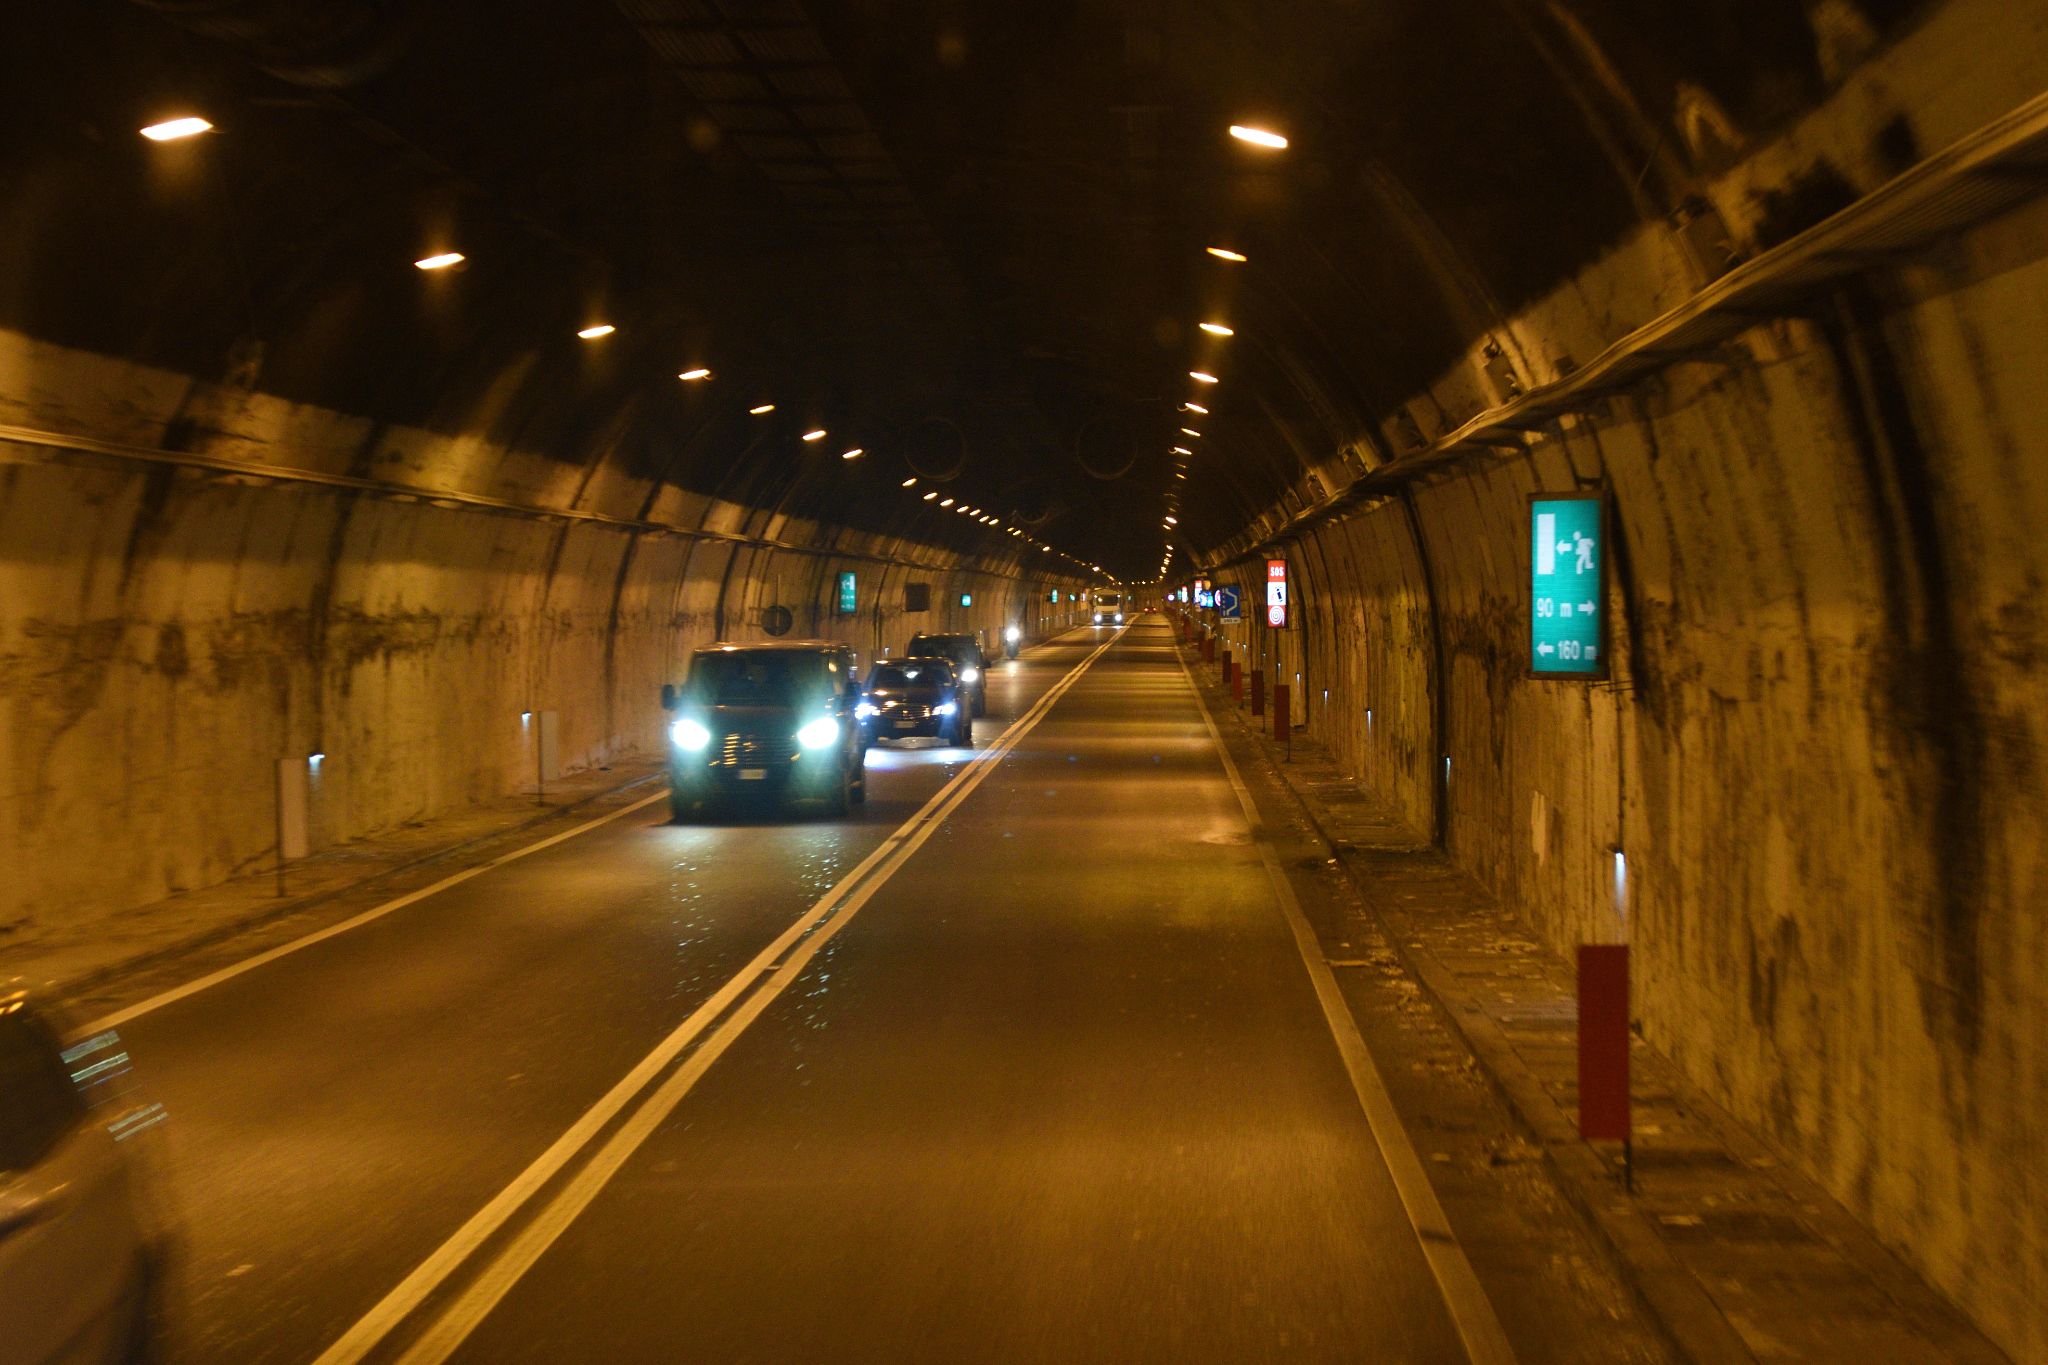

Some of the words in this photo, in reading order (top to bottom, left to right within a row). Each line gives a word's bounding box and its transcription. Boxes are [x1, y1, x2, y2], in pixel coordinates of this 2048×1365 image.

[1270, 566, 1284, 577] SOS
[1536, 597, 1554, 618] 90
[1559, 602, 1573, 618] m
[1557, 640, 1580, 660] 160
[1584, 645, 1597, 660] m
